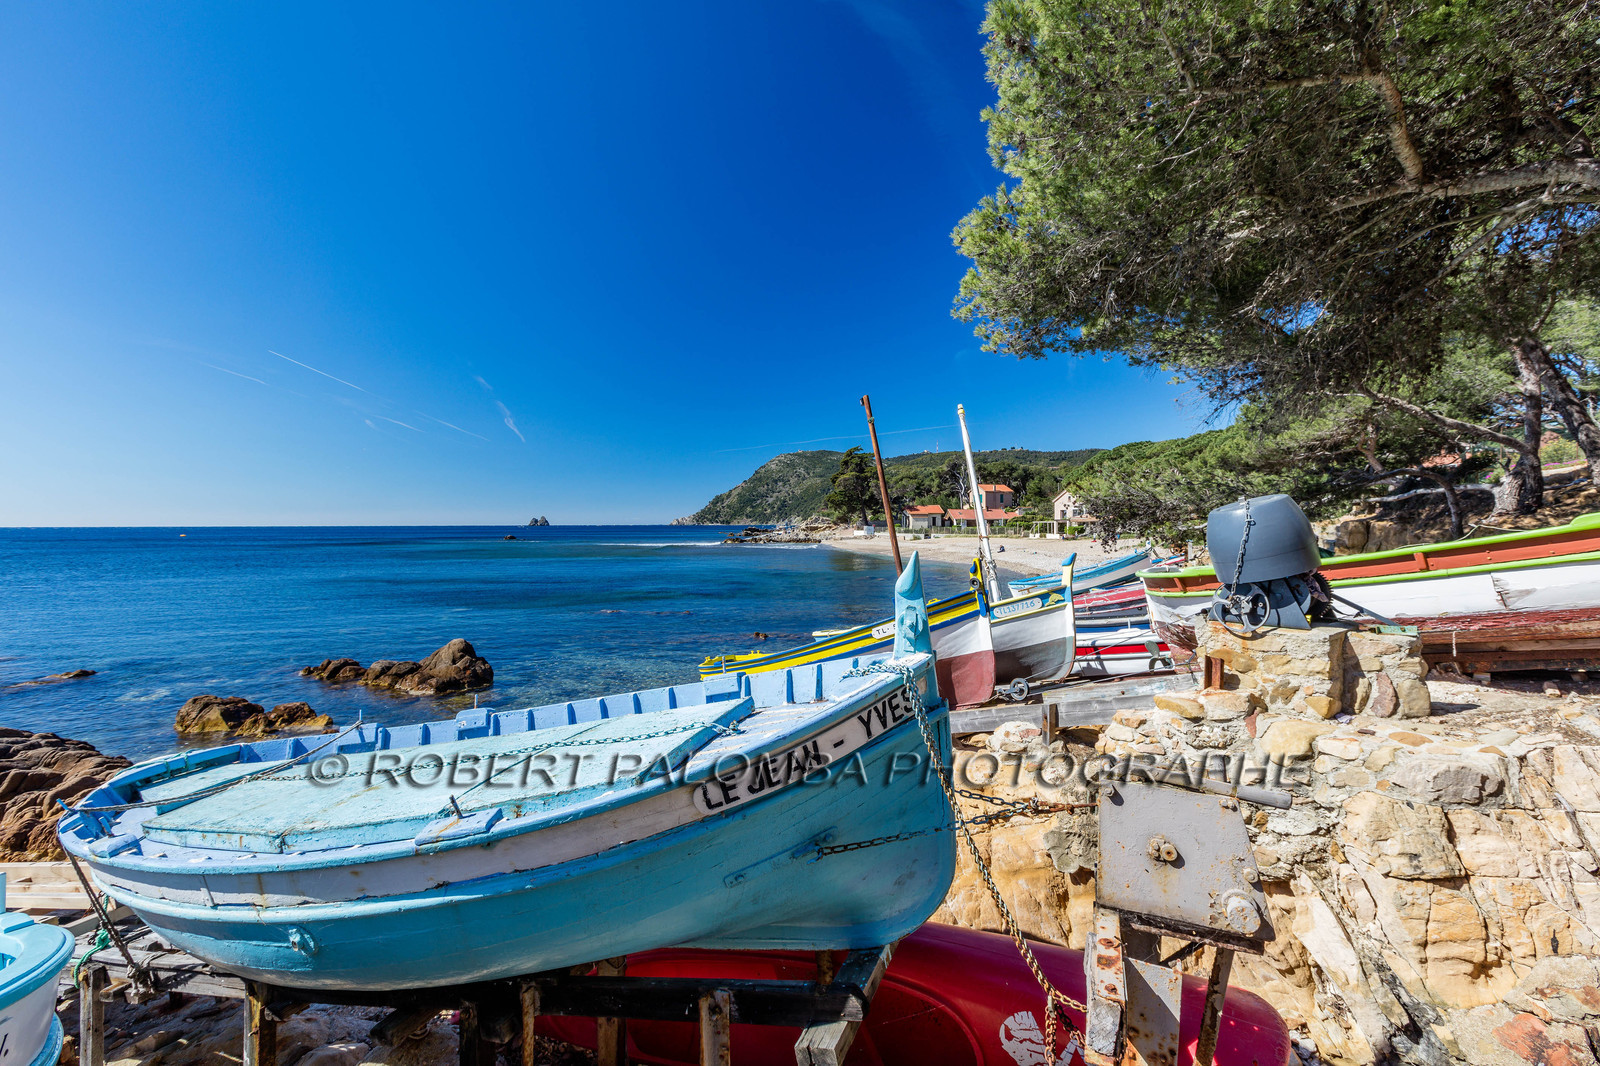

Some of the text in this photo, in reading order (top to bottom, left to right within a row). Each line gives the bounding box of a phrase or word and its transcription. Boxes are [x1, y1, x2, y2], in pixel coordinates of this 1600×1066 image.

[998, 600, 1036, 615] TL137716
[701, 773, 741, 810] LE
[747, 739, 823, 795] JEAN
[856, 686, 916, 740] YVES
